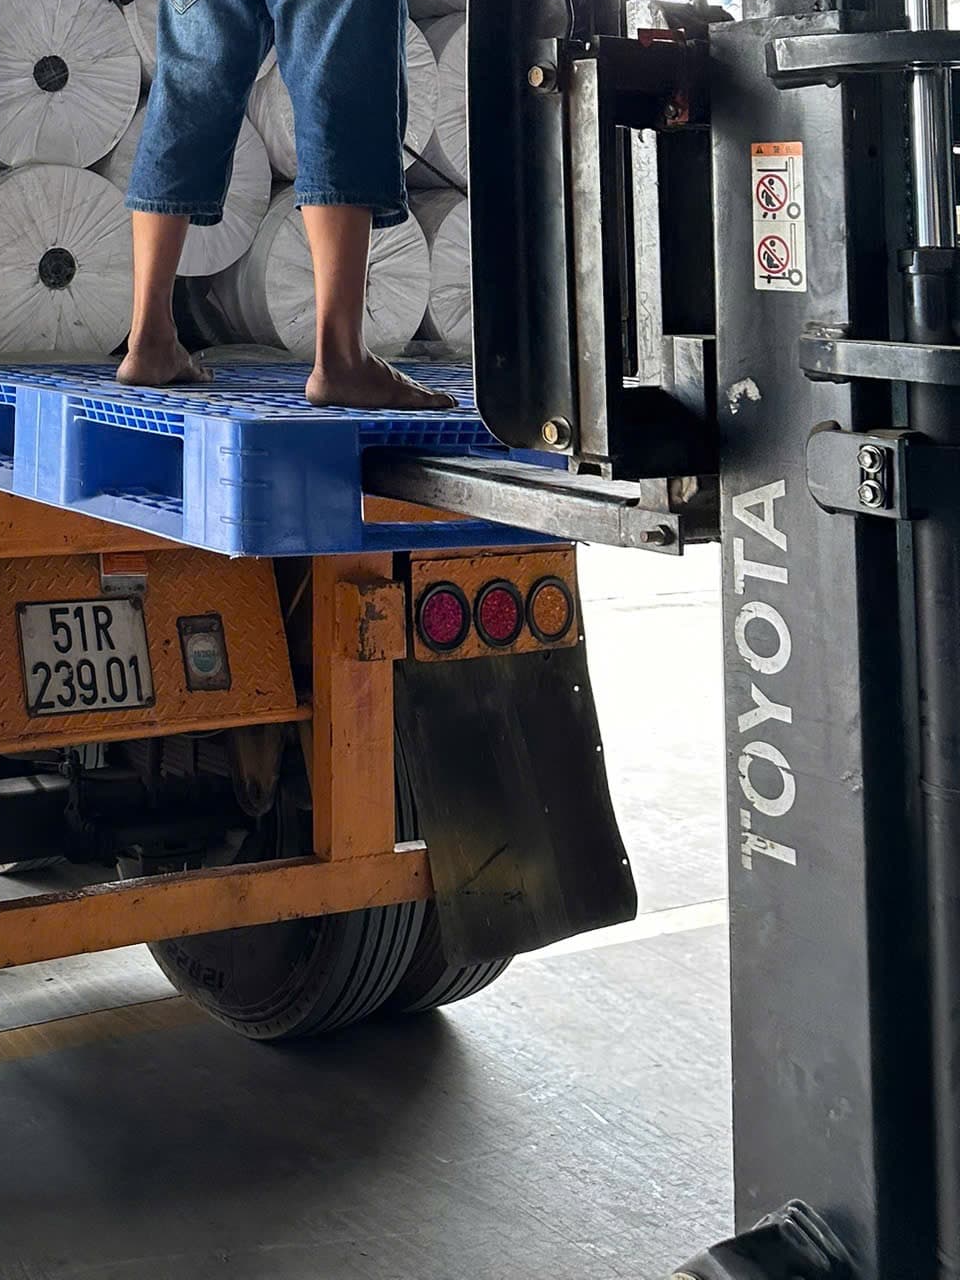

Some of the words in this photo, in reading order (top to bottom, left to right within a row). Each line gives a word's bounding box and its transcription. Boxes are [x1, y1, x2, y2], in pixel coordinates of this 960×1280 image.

[49, 605, 116, 654] 51R
[31, 654, 144, 710] 239.01
[732, 479, 797, 871] TOYOTA
